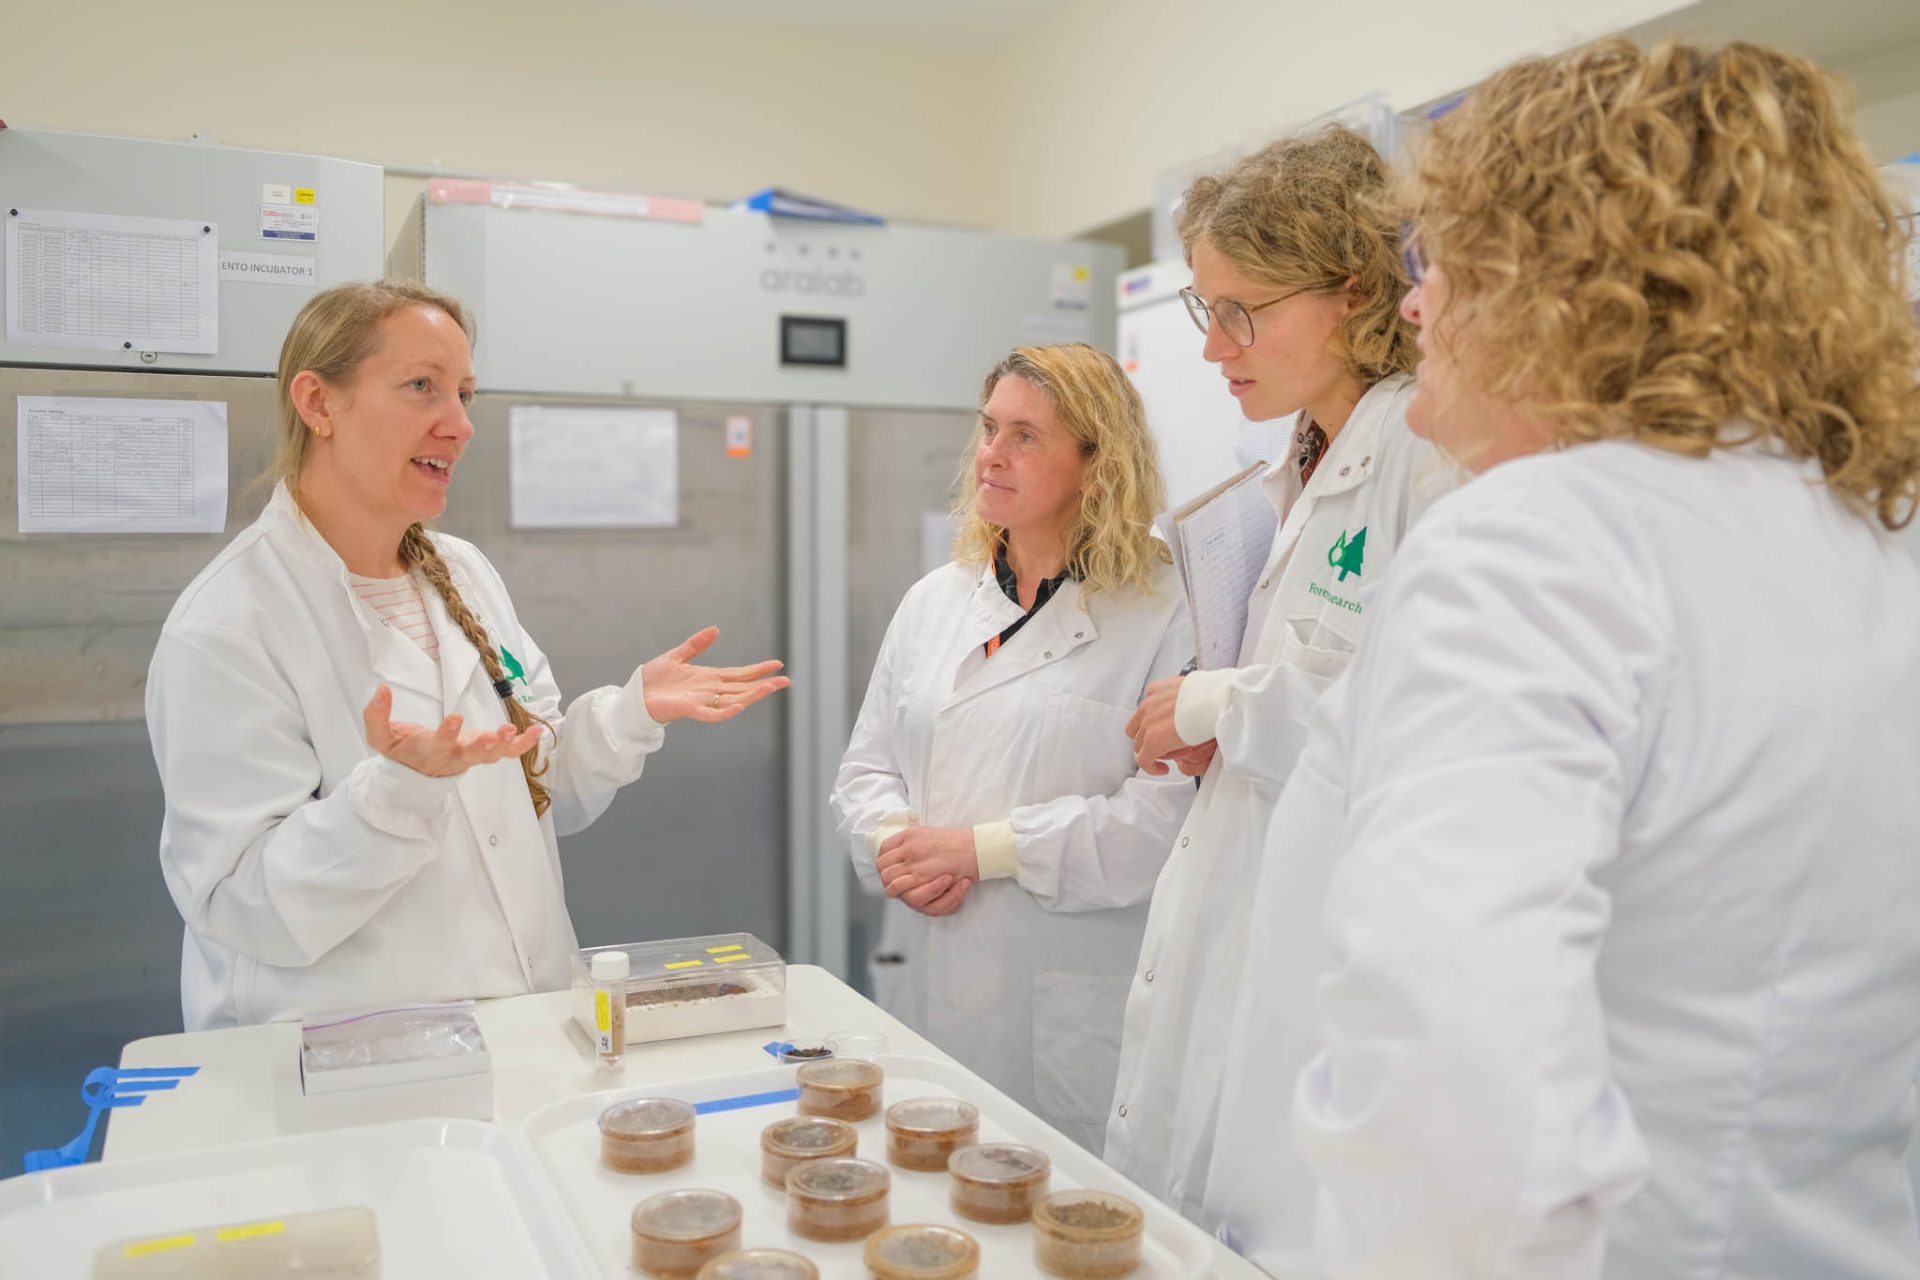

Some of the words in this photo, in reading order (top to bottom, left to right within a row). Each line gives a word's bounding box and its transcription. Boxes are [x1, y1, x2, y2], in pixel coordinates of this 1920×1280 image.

[221, 261, 248, 272] ENTO
[250, 263, 305, 276] INCUBATOR
[307, 267, 313, 276] 1
[759, 266, 867, 298] aralab
